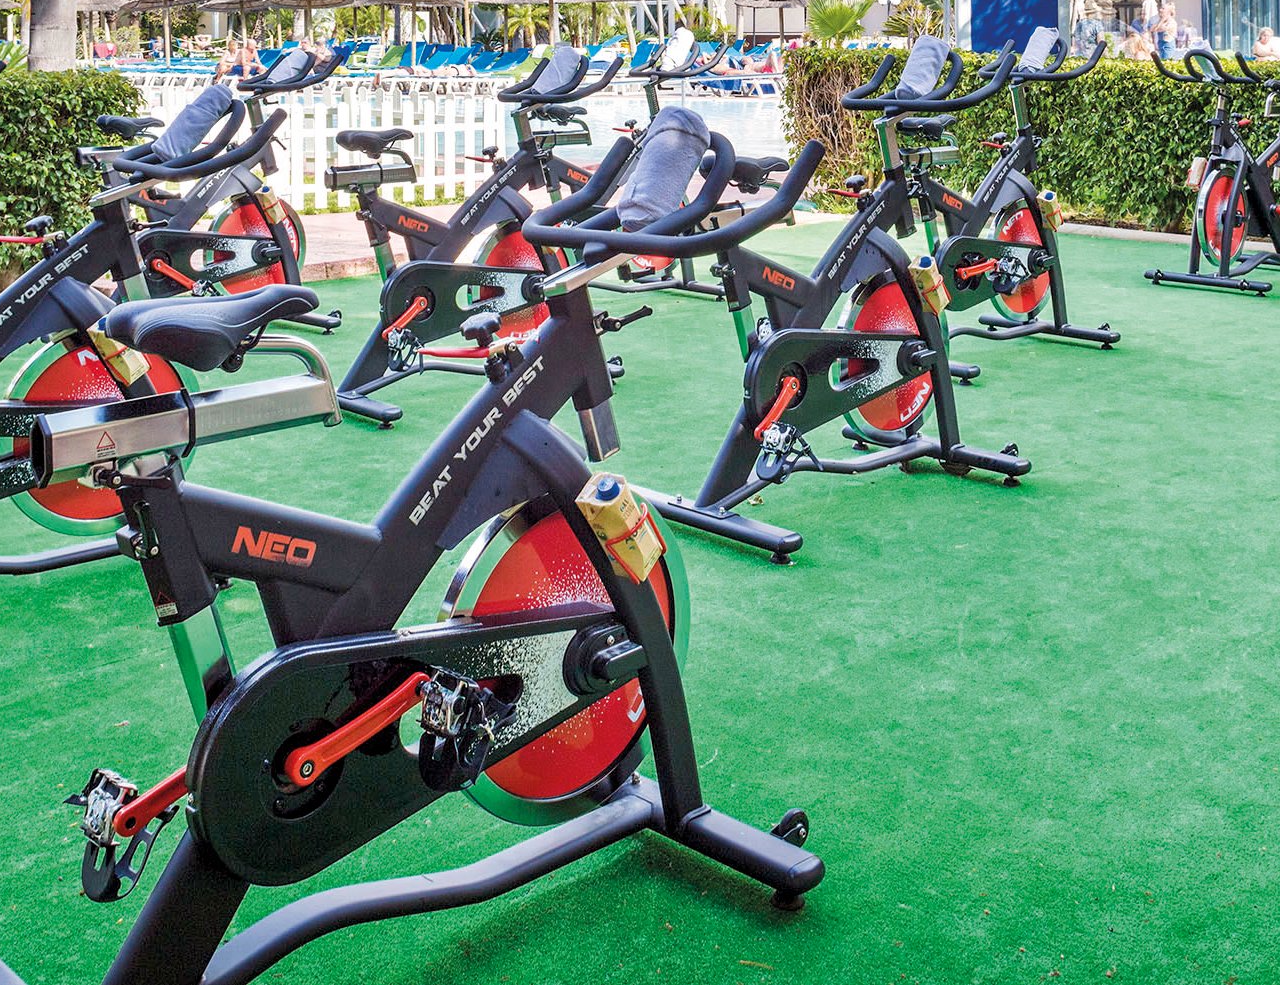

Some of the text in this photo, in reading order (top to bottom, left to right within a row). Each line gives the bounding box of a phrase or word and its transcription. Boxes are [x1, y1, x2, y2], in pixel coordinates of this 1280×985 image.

[567, 169, 589, 184] NEO
[995, 165, 1008, 183] YOUR
[461, 166, 518, 226] BEAT YOUR BEST
[942, 193, 963, 210] NEO
[397, 215, 429, 233] NEO
[828, 200, 886, 279] BEAT YOUR BEST
[15, 273, 54, 305] YOUR
[54, 244, 89, 275] BEST
[762, 266, 795, 291] NEO
[408, 356, 545, 526] BEAT YOUR BEST
[231, 525, 317, 567] NEO
